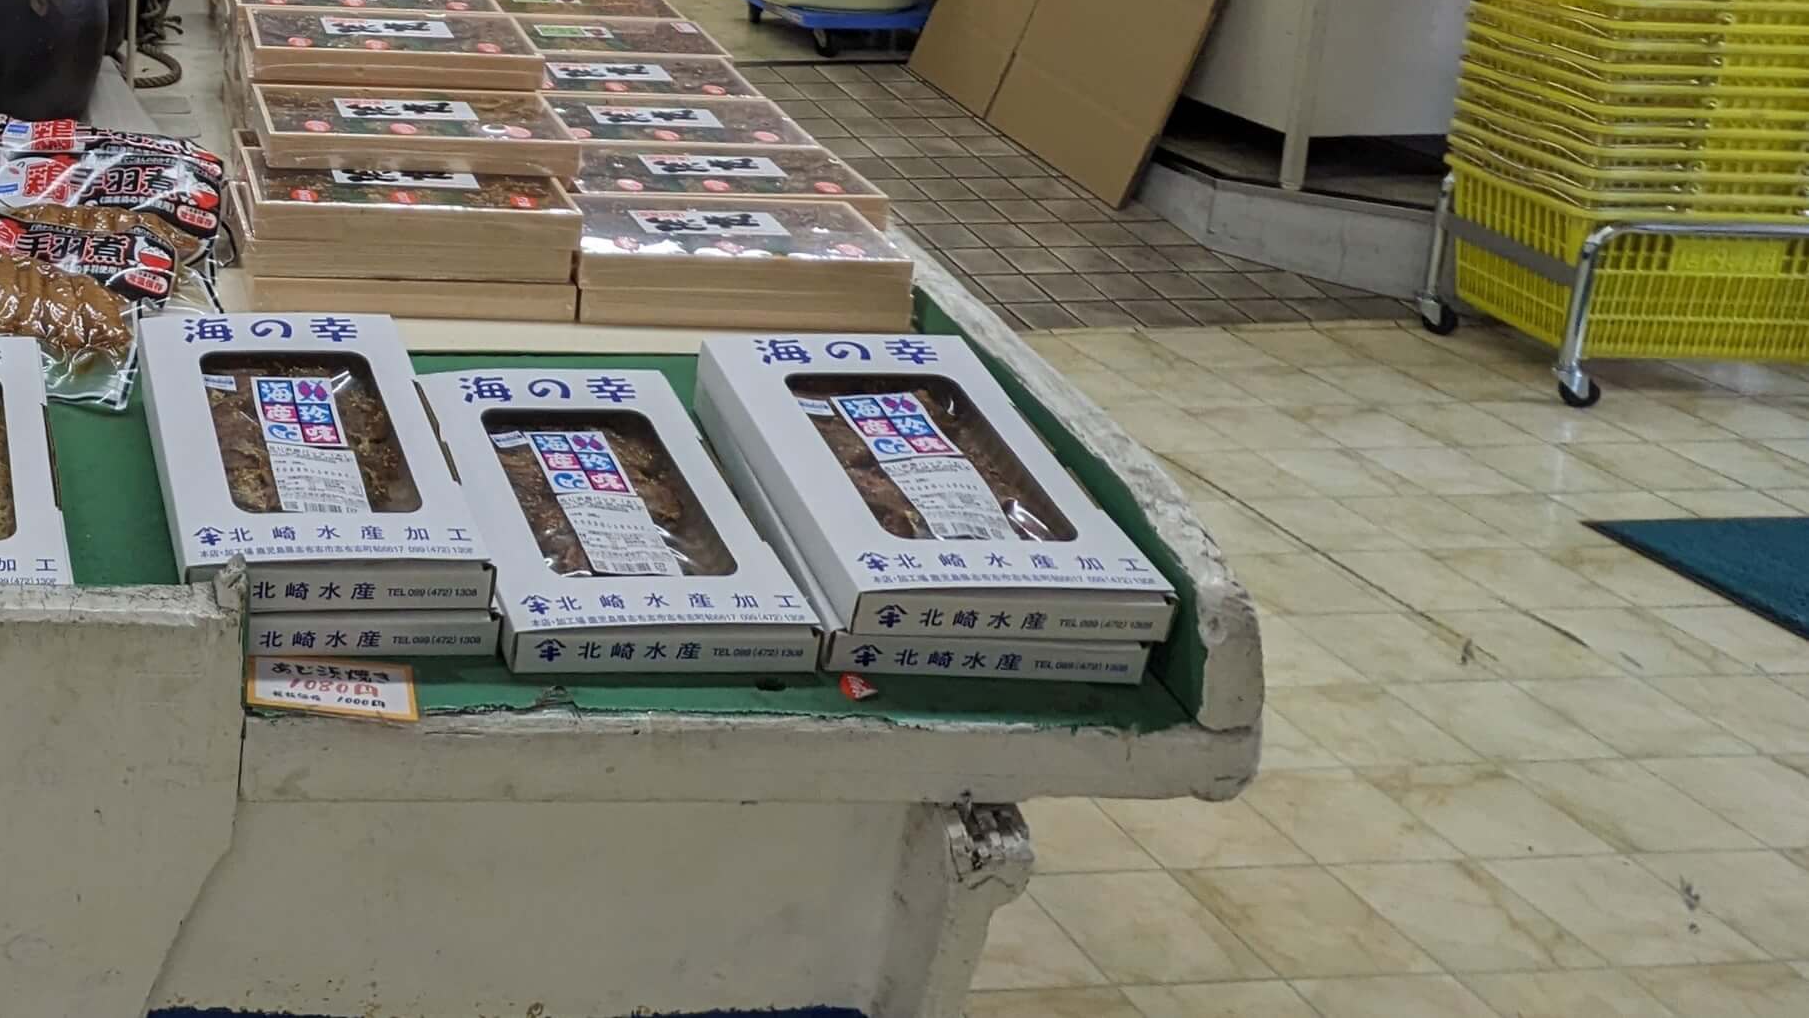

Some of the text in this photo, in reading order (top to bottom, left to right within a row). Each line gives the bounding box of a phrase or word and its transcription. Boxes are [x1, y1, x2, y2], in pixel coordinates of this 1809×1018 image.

[184, 318, 357, 343] 海の幸
[754, 339, 938, 365] 海の幸
[459, 377, 637, 403] 海の幸
[230, 526, 472, 542] 北崎水産加工
[894, 553, 1150, 572] 北崎水産加工
[253, 582, 376, 600] 北崎水産
[556, 593, 802, 611] 北崎水産加工
[920, 608, 1046, 630] 北崎水産
[260, 630, 382, 648] 北崎水産
[578, 643, 702, 660] 北崎水産
[895, 648, 1022, 671] 北崎水産
[290, 678, 379, 697] 1080円
[337, 697, 386, 708] 1000円
